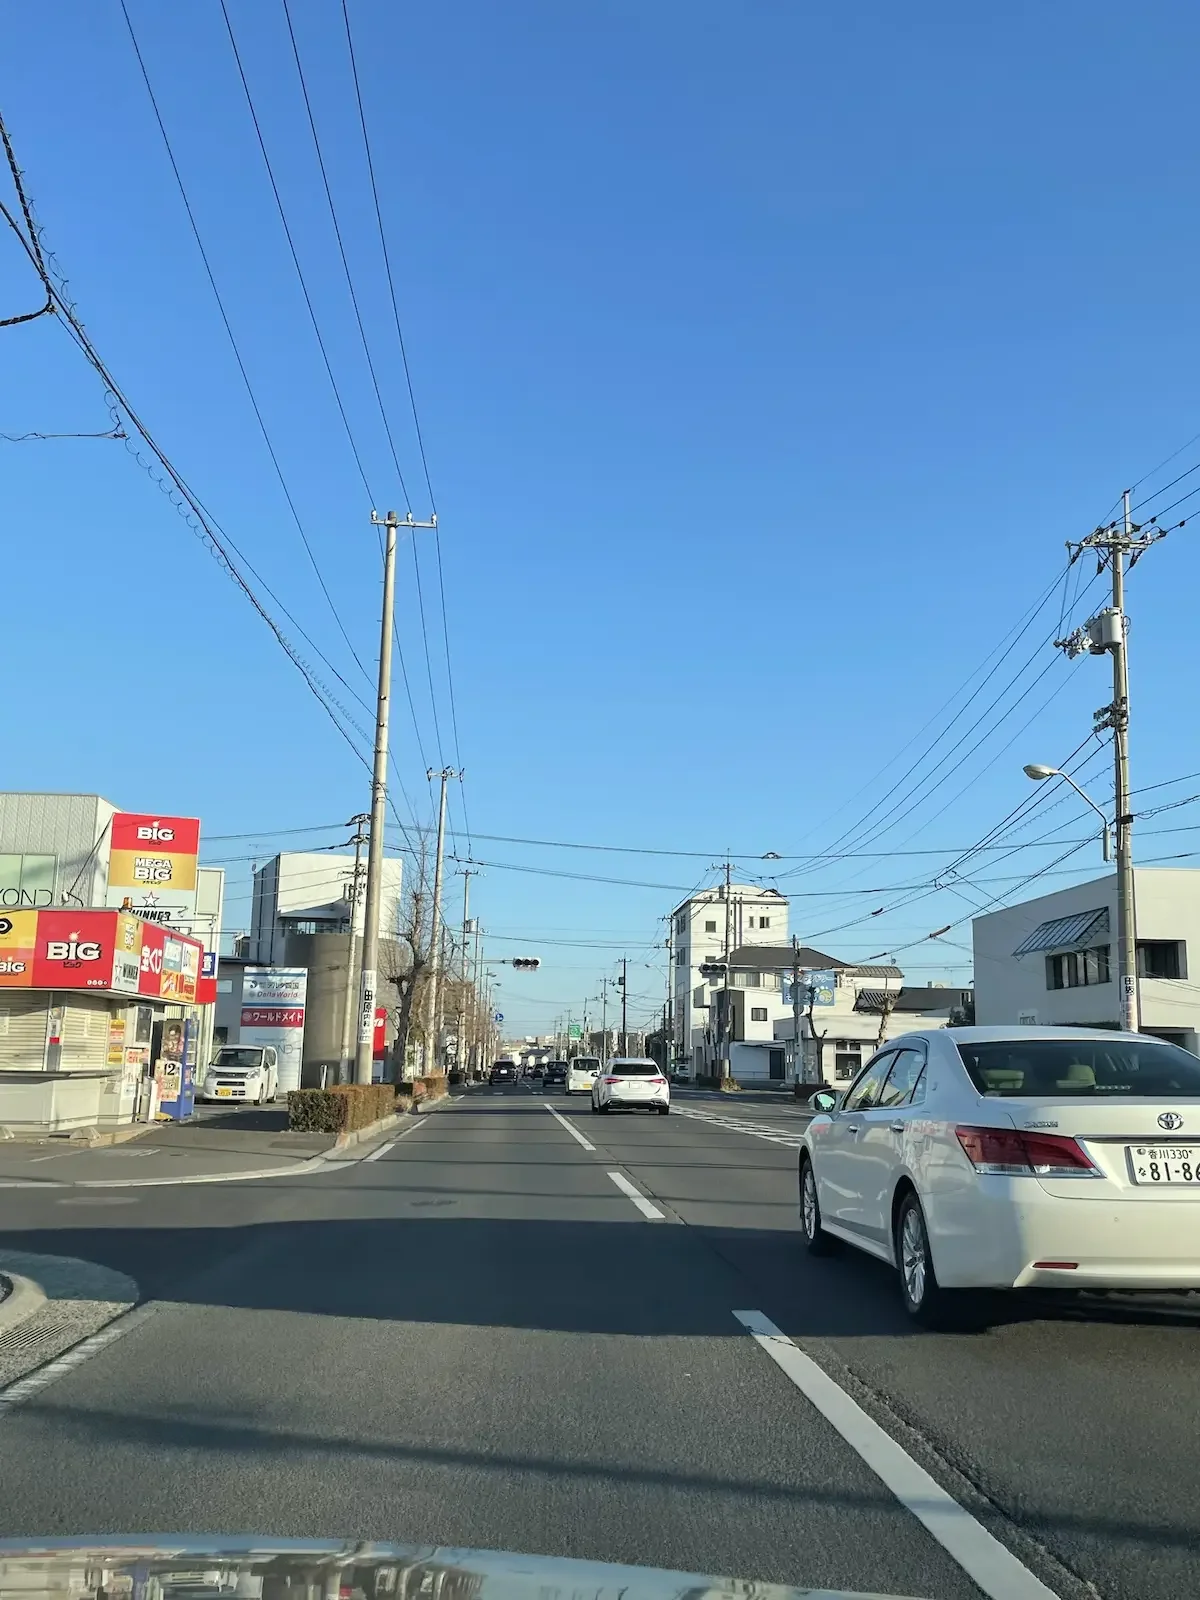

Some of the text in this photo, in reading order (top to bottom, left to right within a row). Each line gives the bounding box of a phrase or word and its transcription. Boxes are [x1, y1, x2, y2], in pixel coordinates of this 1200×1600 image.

[137, 826, 175, 841] BIG
[135, 857, 172, 868] MEGA
[134, 867, 172, 881] BIG
[46, 941, 101, 961] BIG
[140, 944, 163, 975] 宝くじ
[252, 1011, 303, 1022] ワールドメイト
[1147, 1149, 1190, 1160] 香川330
